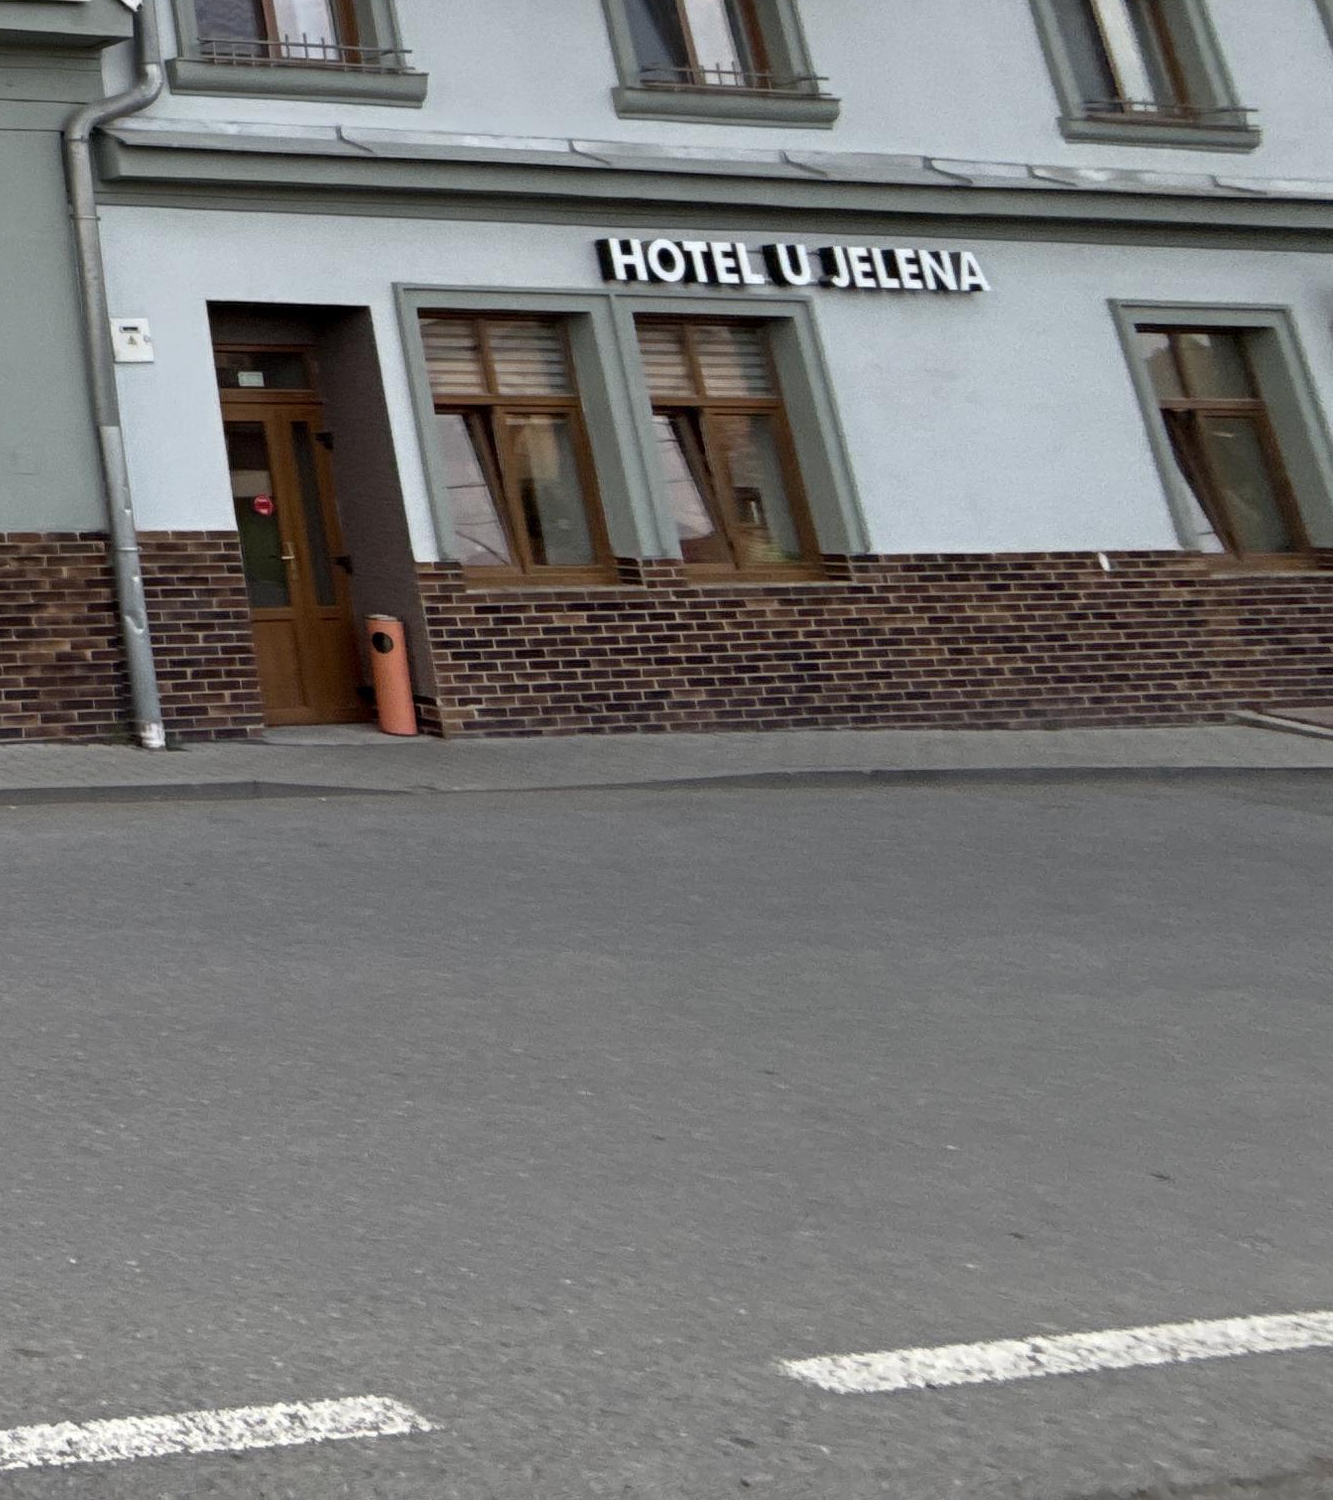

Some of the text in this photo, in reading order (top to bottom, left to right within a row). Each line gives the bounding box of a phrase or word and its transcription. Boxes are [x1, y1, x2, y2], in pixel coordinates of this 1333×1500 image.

[607, 238, 992, 292] HOTEL U JELENA
